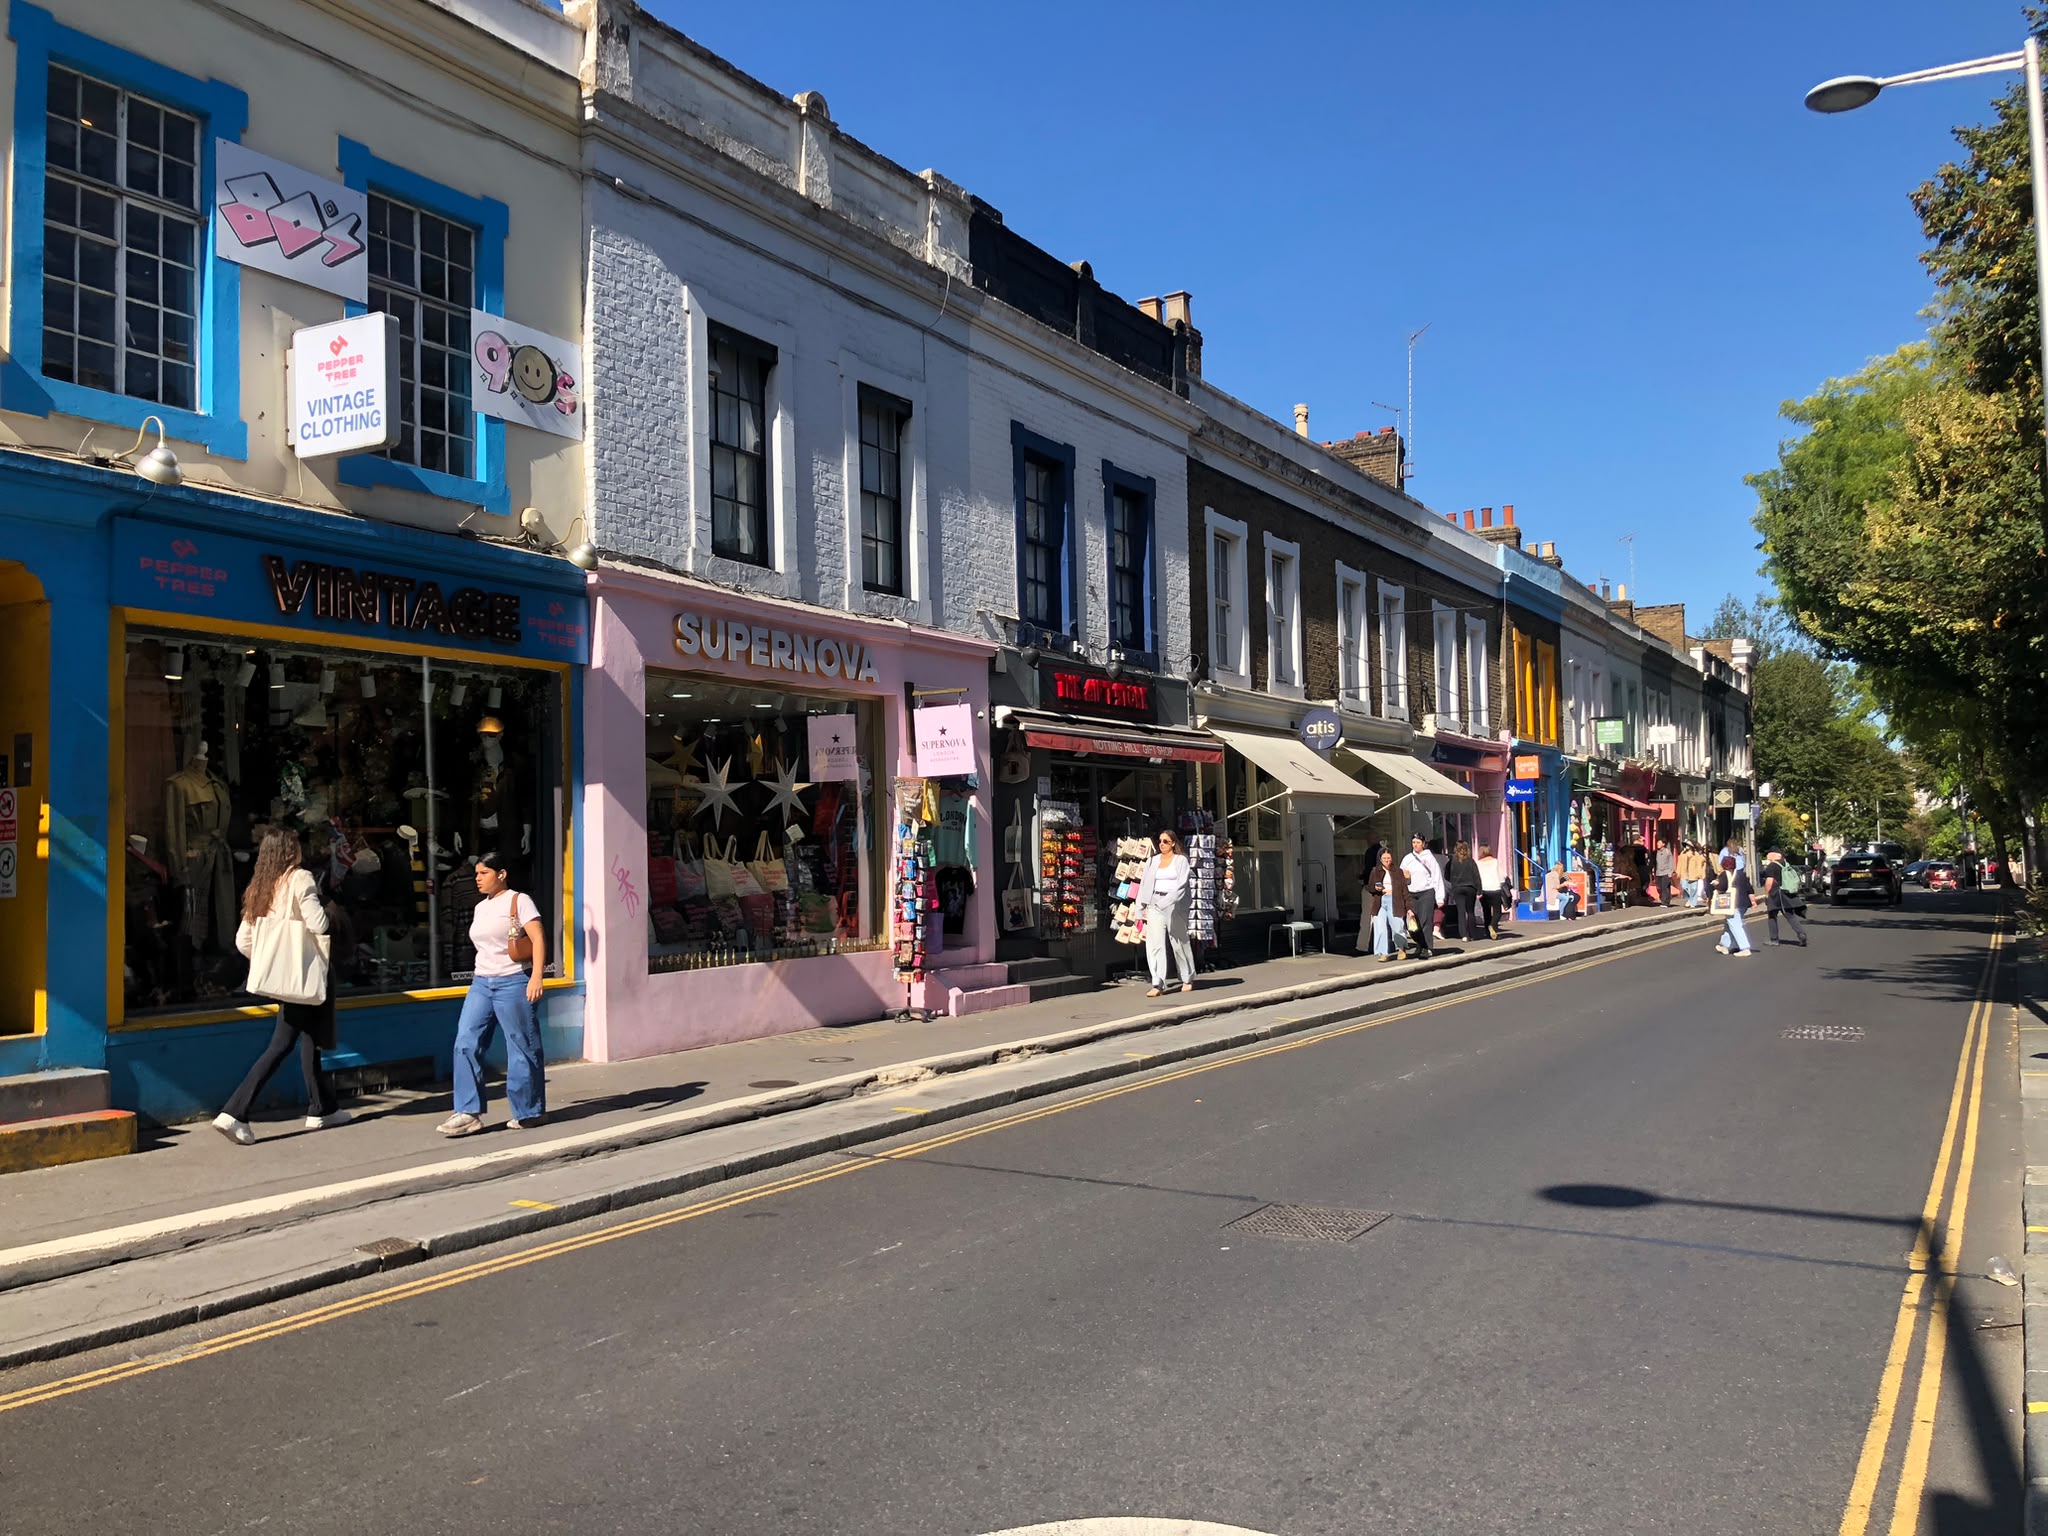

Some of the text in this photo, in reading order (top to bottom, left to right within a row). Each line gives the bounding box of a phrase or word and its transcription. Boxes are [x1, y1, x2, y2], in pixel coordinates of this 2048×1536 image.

[317, 354, 364, 372] PEPPER
[325, 368, 357, 382] TREE
[307, 388, 375, 417] VINTAGE
[300, 409, 381, 440] CLOTHING
[139, 556, 228, 583] PEPPER
[154, 575, 215, 597] TREE
[261, 553, 522, 643] VINTAGE
[527, 617, 585, 636] PEPPER
[537, 631, 577, 648] TREE
[673, 612, 880, 683] SUPERNOVA
[1054, 672, 1081, 700] THE
[1306, 720, 1335, 735] atis
[921, 738, 967, 750] SUPERNOVA
[1093, 739, 1173, 756] NOTTING HILL GIFT SHOP
